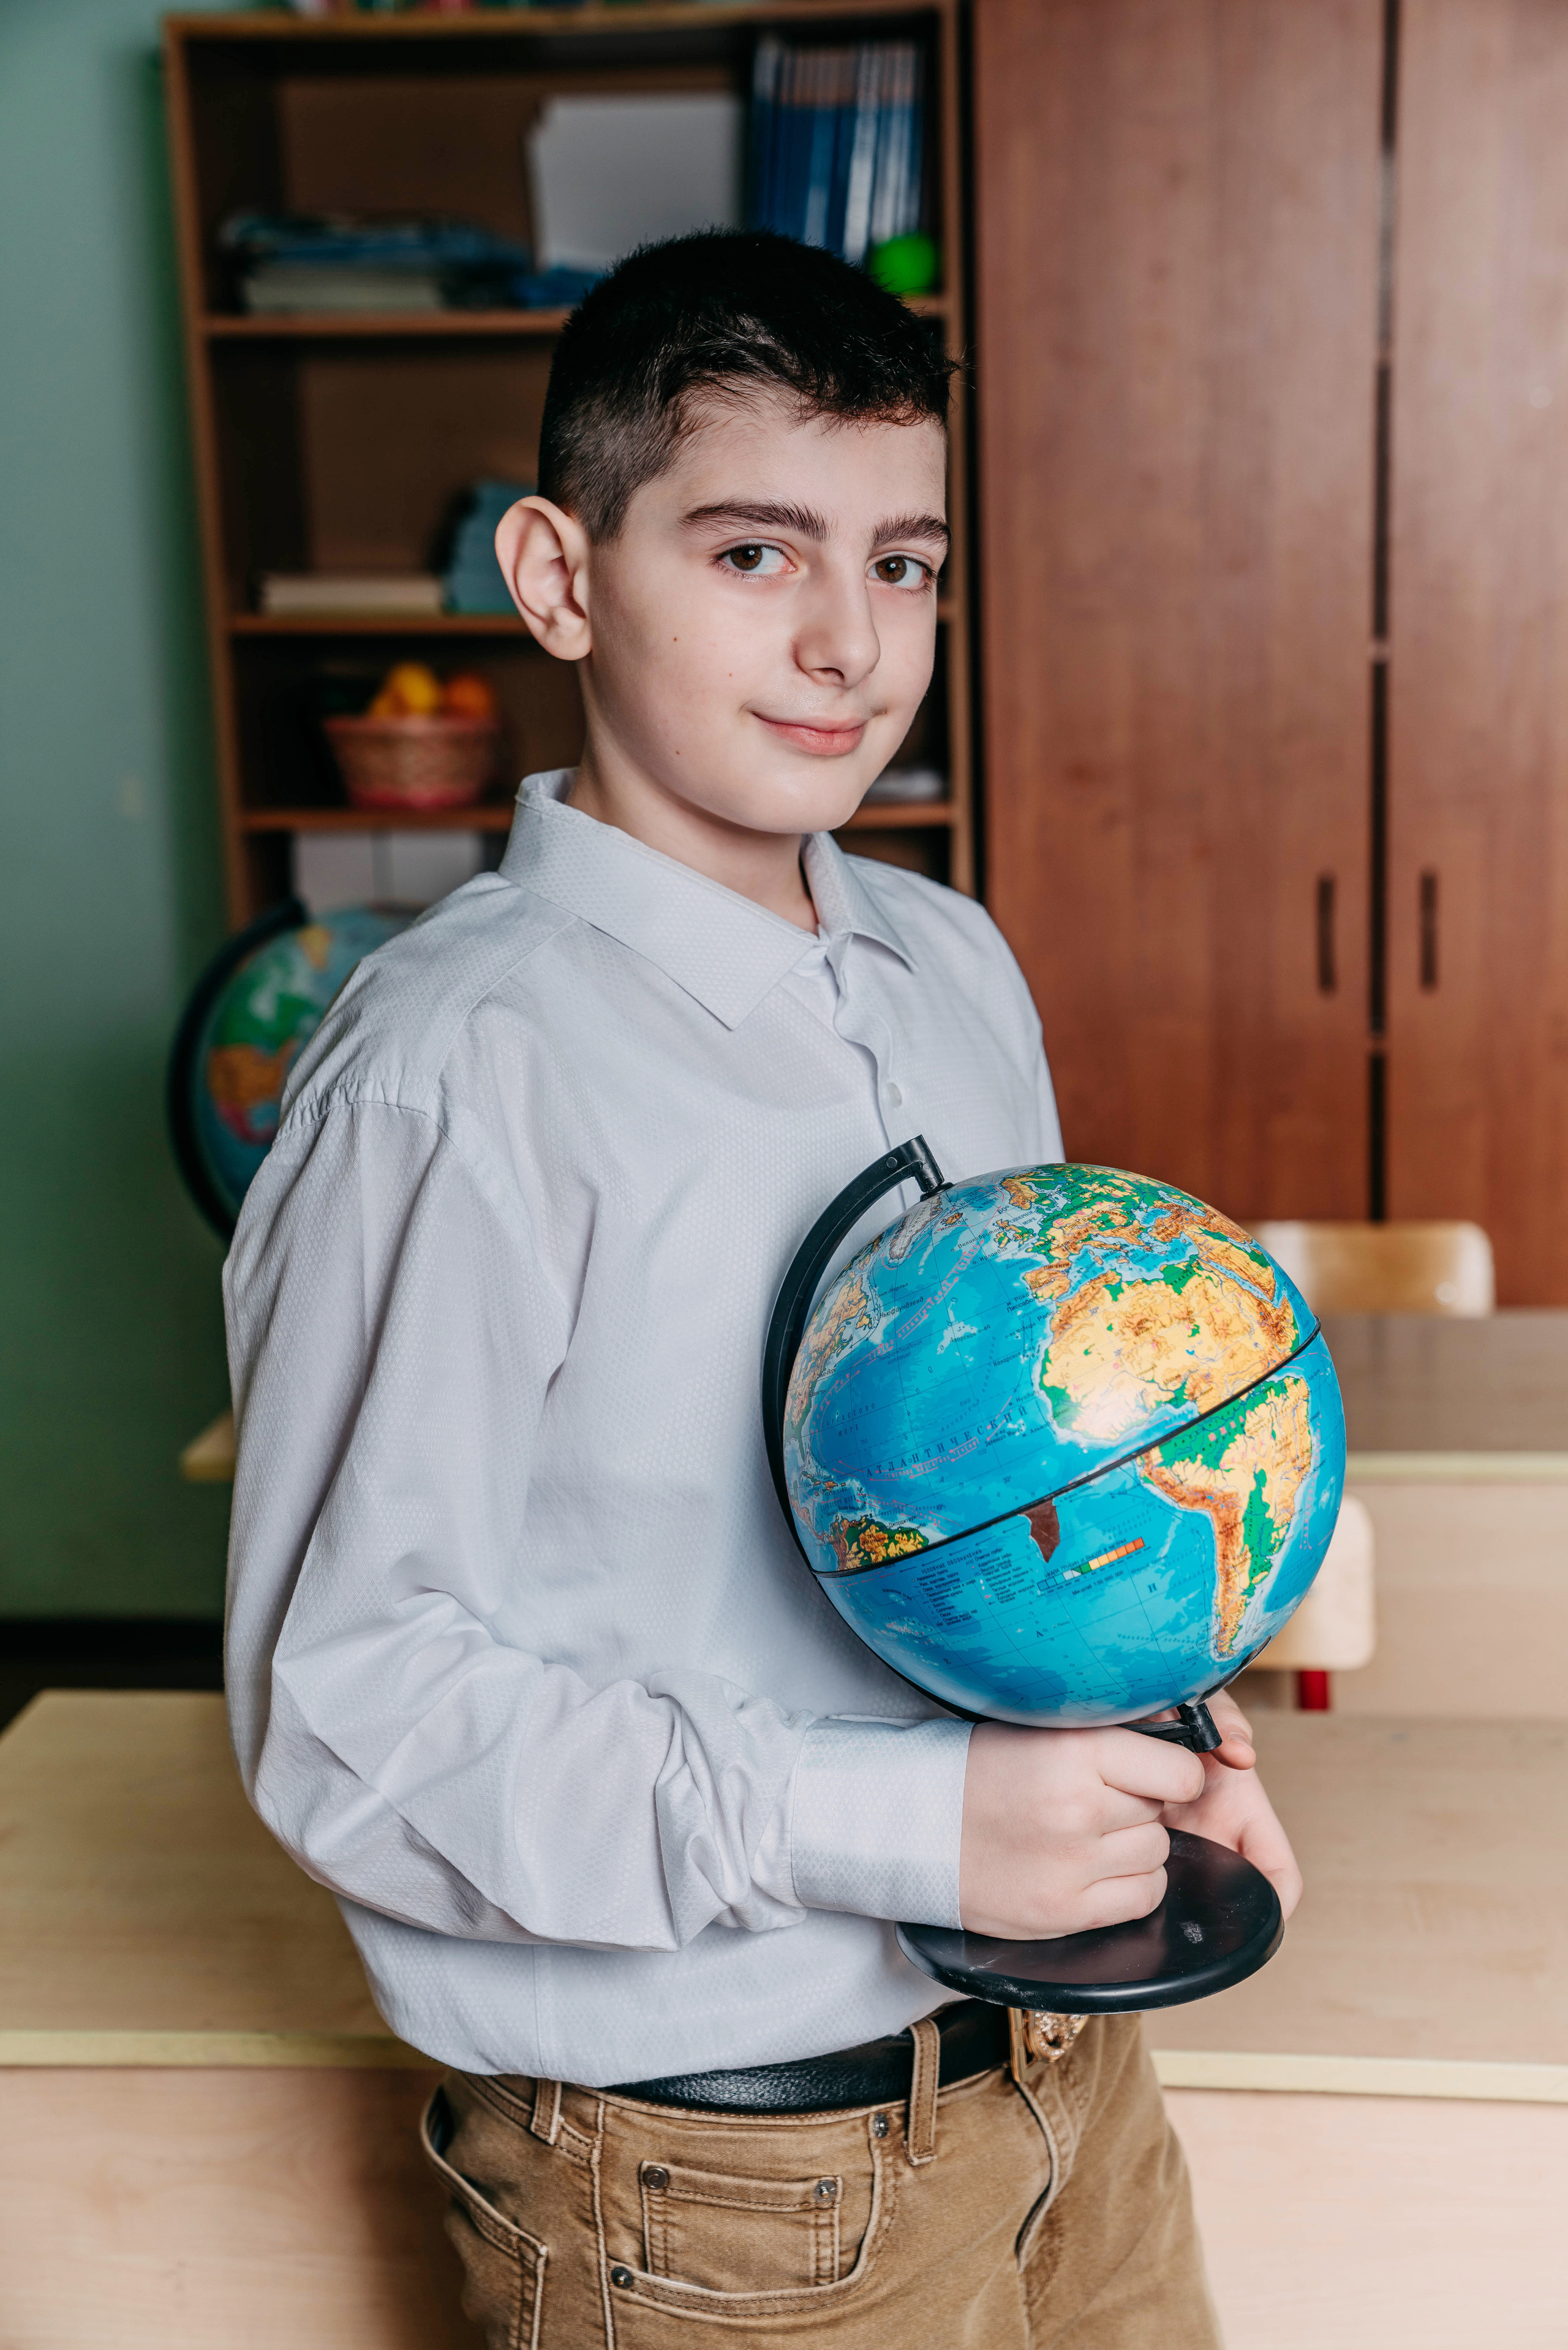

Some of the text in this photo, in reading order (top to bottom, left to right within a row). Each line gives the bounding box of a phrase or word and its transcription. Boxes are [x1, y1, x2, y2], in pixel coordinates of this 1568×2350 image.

[1009, 1210, 1035, 1223] СЕВЕРНОЕ
[1022, 1217, 1036, 1226] МОРЕ
[1042, 1213, 1063, 1224] Берлин
[940, 1218, 968, 1232] Исландия
[1063, 1221, 1082, 1230] Прага
[957, 1224, 1008, 1249] Великобритания
[980, 1246, 1008, 1262] Ирландия
[1005, 1254, 1038, 1270] Бискайский
[1019, 1262, 1035, 1271] залив
[875, 1282, 909, 1300] Сент-Чарльз
[1014, 1293, 1030, 1303] Рока
[869, 1243, 979, 1361] СЕВЕРО-АТЛАНТИЧЕСКОЕ ТЕЧЕНИЕ
[880, 1296, 924, 1319] Ньюфаундленд
[1088, 1306, 1099, 1316] 30°
[950, 1324, 991, 1344] Азорские о-ва
[992, 1352, 1022, 1368] Канарские
[1016, 1390, 1040, 1403] Нуадибу
[838, 1424, 859, 1437] МОРЕ
[867, 1404, 1028, 1478] АТЛАНТИЧЕСКИЙ
[921, 1562, 946, 1574] УСЛОВНЫЕ
[947, 1549, 982, 1566] ОБОЗНАЧЕНИЯ
[1044, 1567, 1060, 1578] ШКАЛА
[1060, 1559, 1079, 1571] ГЛУБИН
[1085, 1550, 1102, 1561] ВЫСОТ
[1109, 1538, 1128, 1550] МЕТРАХ
[1072, 1584, 1093, 1596] Масштаб
